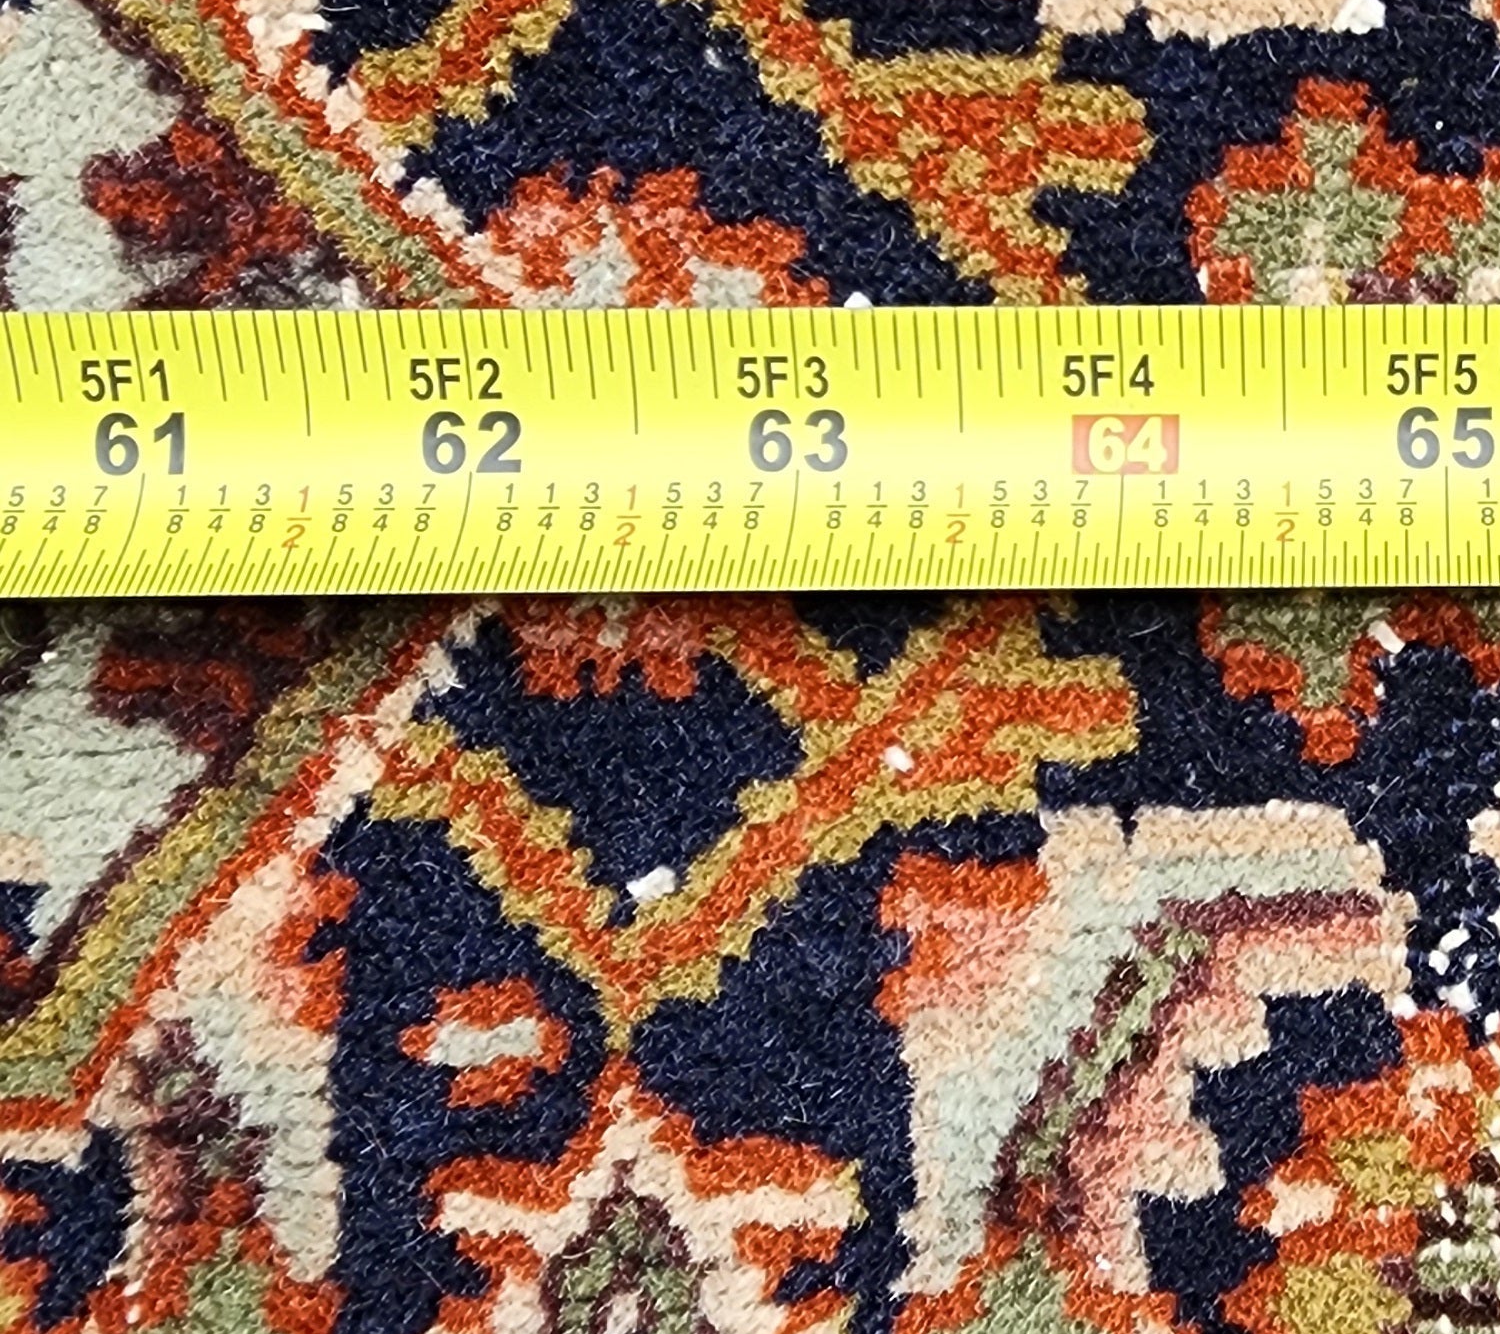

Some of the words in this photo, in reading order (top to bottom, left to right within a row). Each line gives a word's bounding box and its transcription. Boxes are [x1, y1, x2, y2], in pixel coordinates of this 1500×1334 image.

[95, 412, 185, 475] 61
[422, 411, 522, 474] 62
[748, 409, 848, 472] 63
[1087, 417, 1167, 473] 64
[1396, 407, 1495, 469] 65
